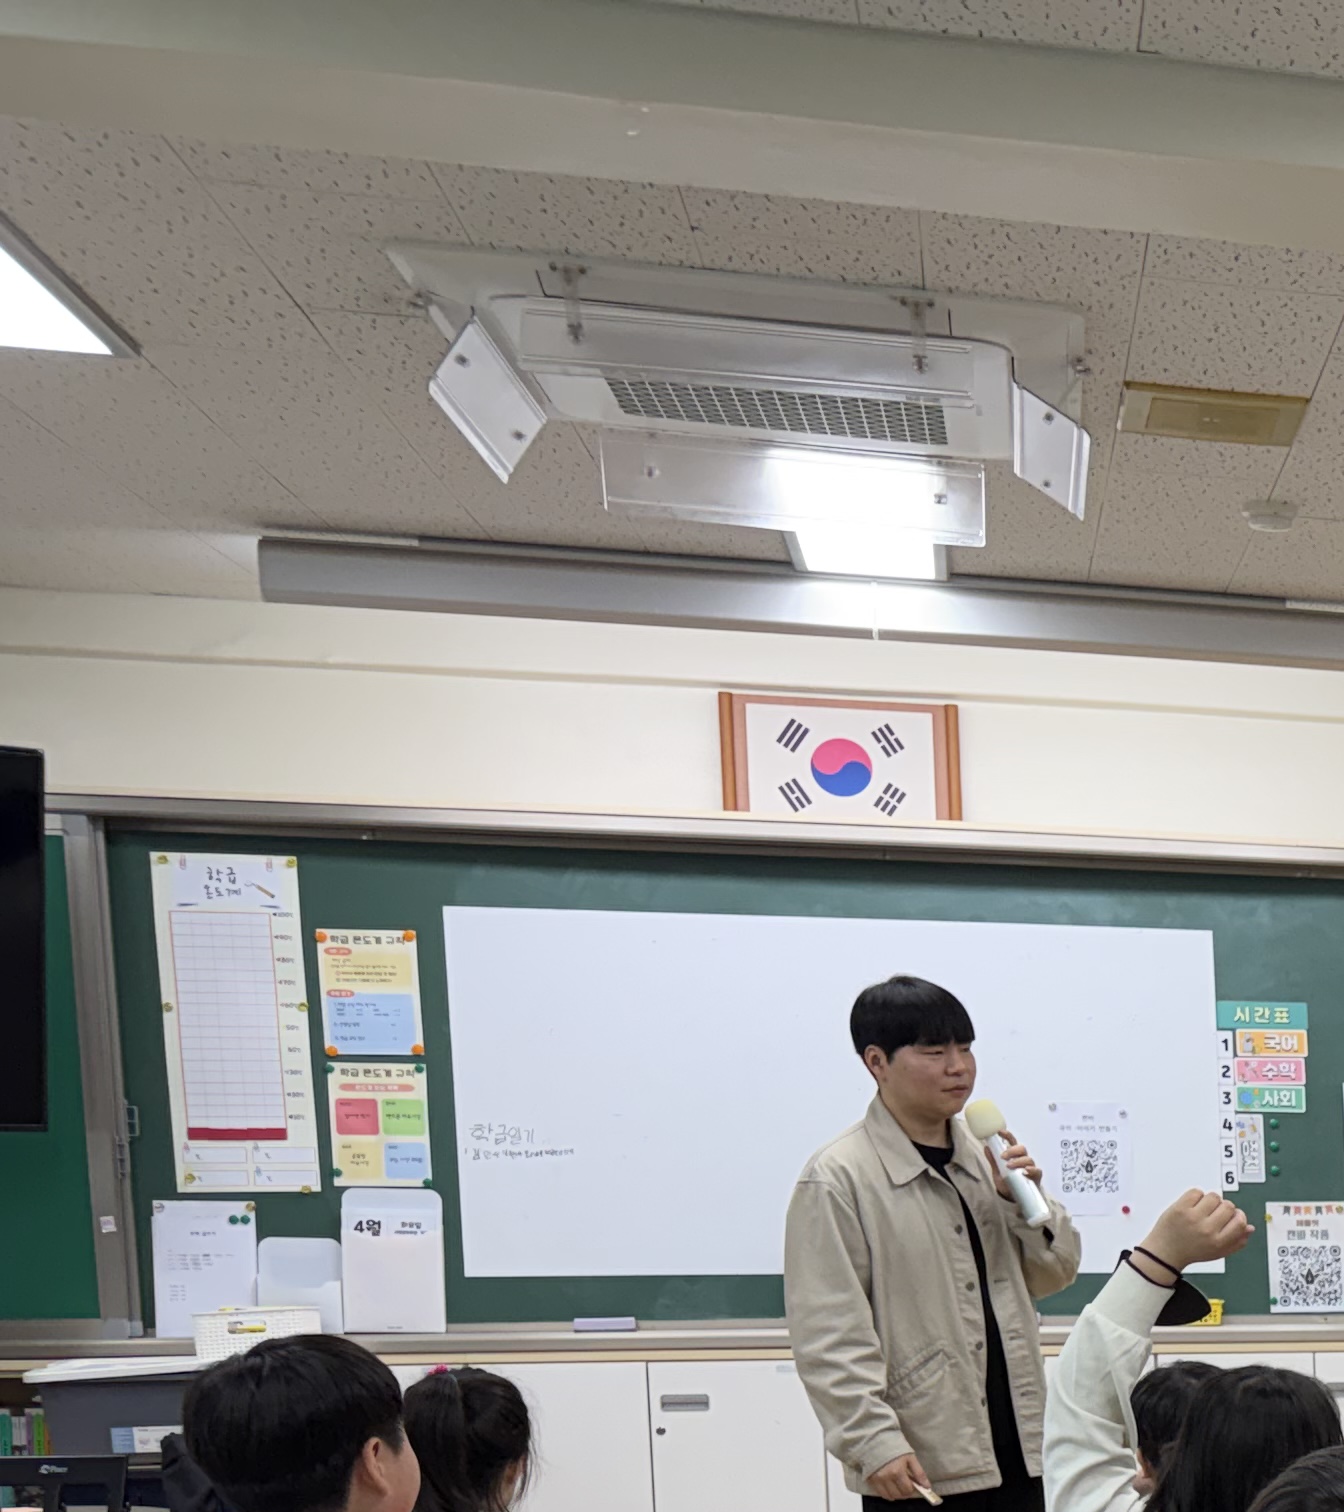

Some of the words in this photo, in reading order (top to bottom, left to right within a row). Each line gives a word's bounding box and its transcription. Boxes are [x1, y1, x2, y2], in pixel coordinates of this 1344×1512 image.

[207, 866, 236, 884] 학급
[1233, 1006, 1290, 1024] 시간표
[1221, 1038, 1229, 1051] 1
[1263, 1033, 1299, 1053] 국어
[1221, 1065, 1231, 1078] 2
[1261, 1061, 1297, 1080] 수학
[1222, 1091, 1232, 1105] 3
[1261, 1089, 1297, 1108] 사회
[1222, 1118, 1233, 1132] 4
[468, 1123, 535, 1146] 학급일기
[1224, 1145, 1234, 1158] 5
[1225, 1171, 1235, 1184] 6
[353, 1219, 382, 1237] 4월
